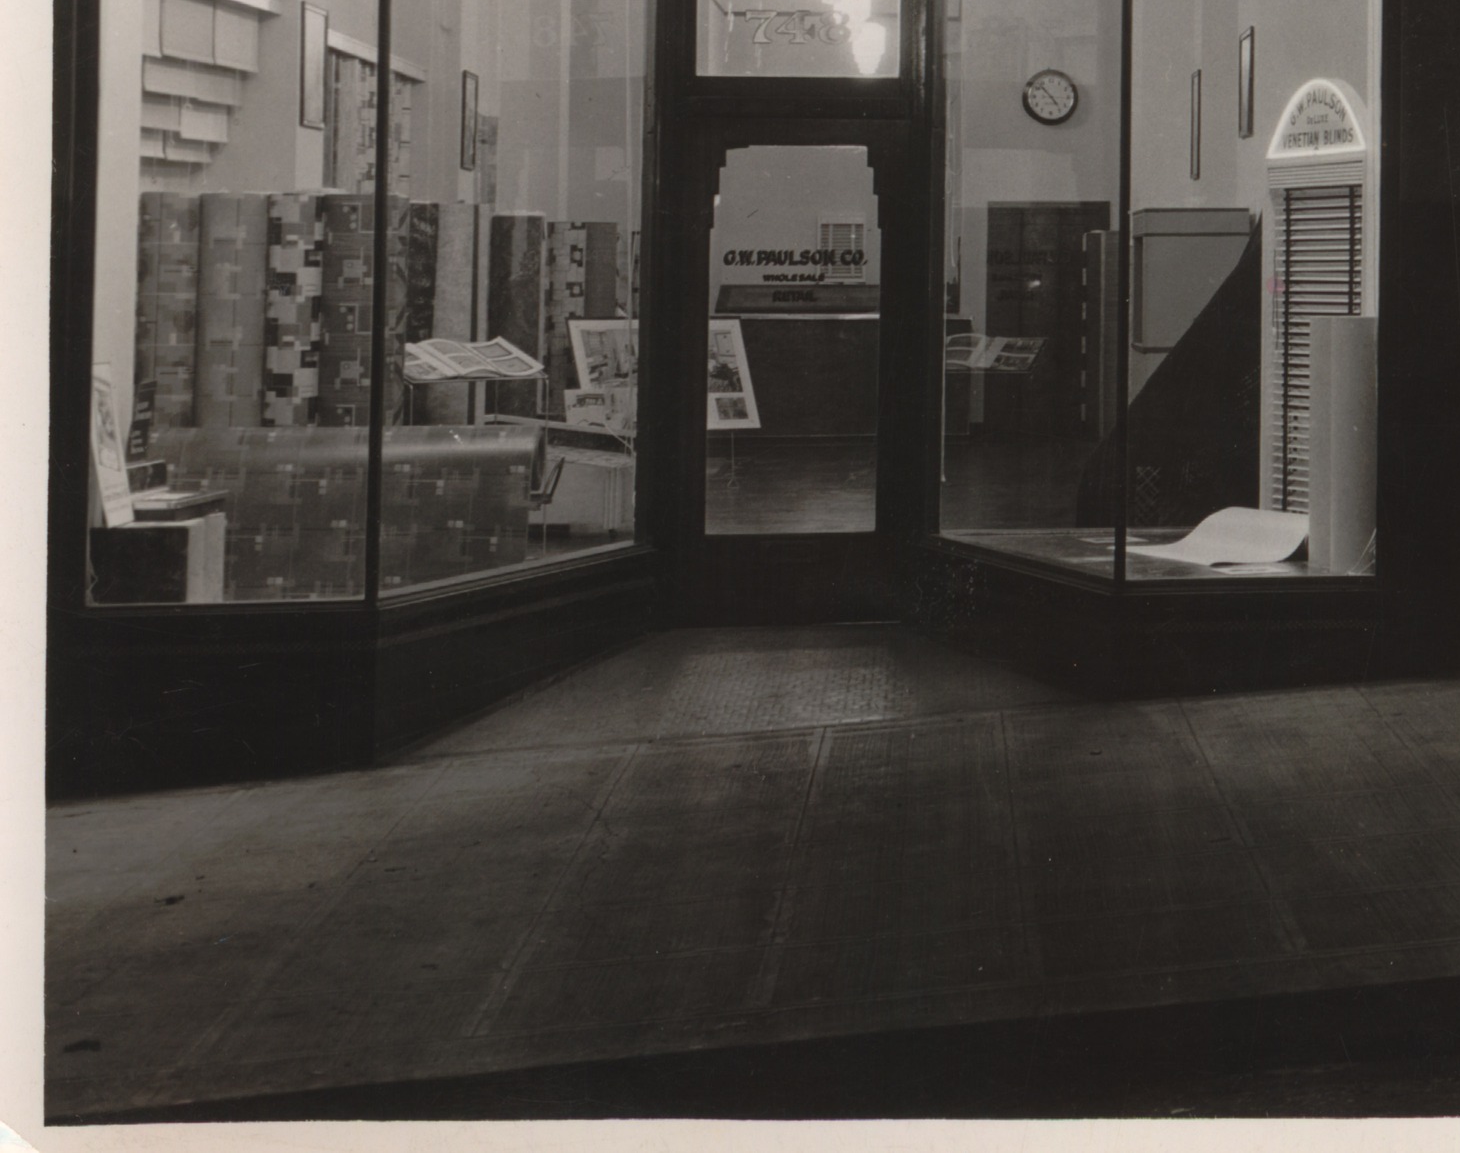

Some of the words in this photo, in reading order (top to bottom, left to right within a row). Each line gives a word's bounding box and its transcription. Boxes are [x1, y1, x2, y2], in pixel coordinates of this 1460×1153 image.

[744, 9, 852, 46] 748
[1323, 127, 1355, 147] BLINDS
[756, 249, 836, 267] PAULSON
